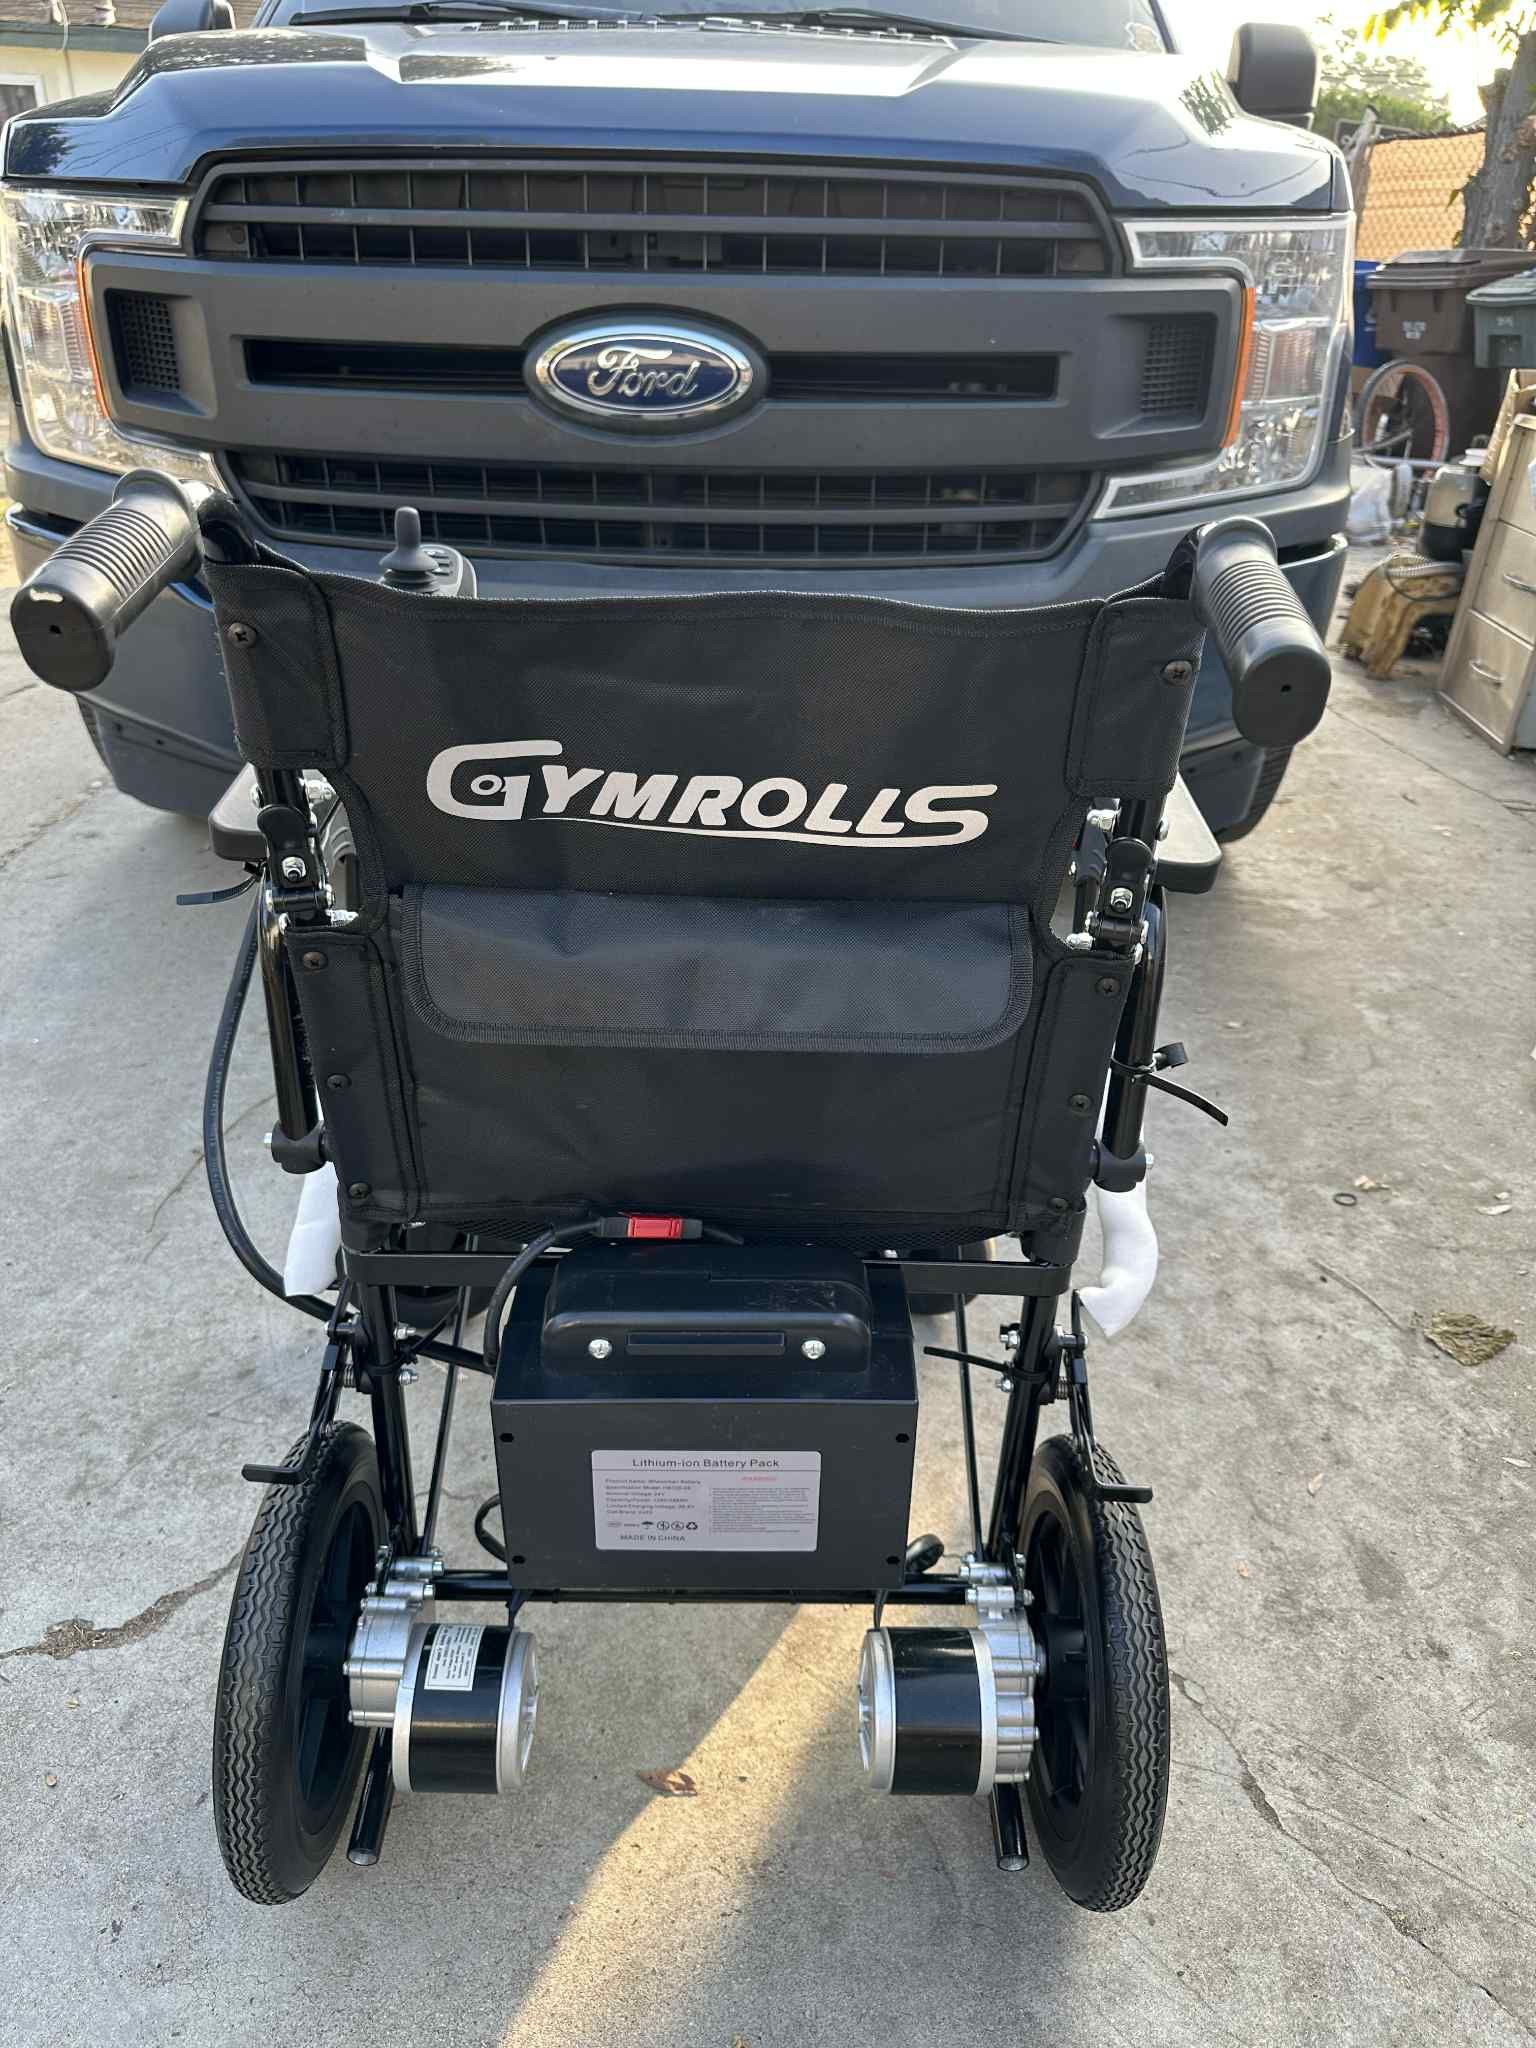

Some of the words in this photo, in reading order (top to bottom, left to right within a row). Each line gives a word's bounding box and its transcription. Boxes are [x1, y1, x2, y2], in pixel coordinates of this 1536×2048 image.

[587, 345, 700, 397] Ford
[426, 739, 998, 847] GYMROLLS
[632, 1458, 700, 1467] Lithium-ion
[703, 1458, 746, 1469] Battery
[750, 1458, 779, 1468] Pack
[620, 1534, 644, 1542] MADE
[647, 1534, 656, 1542] IN
[658, 1534, 686, 1542] CHINA
